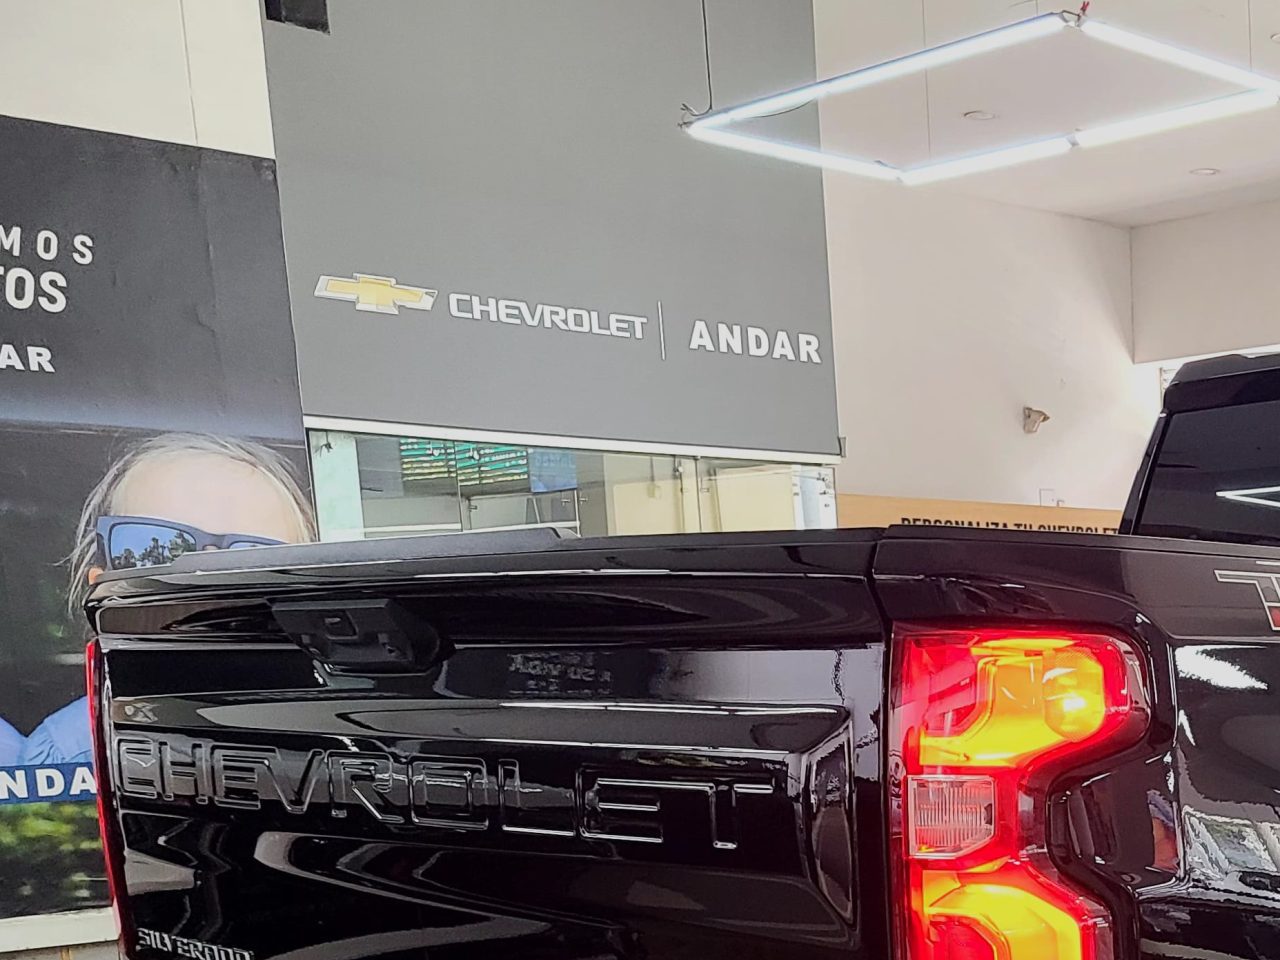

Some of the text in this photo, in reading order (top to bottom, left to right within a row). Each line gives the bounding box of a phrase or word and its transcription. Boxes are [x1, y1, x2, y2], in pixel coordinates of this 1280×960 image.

[0, 225, 94, 265] MOS
[0, 265, 67, 313] OS
[448, 292, 823, 364] CHEVROLET ANDAR
[0, 343, 55, 373] AR
[114, 736, 776, 850] CHEVROLET
